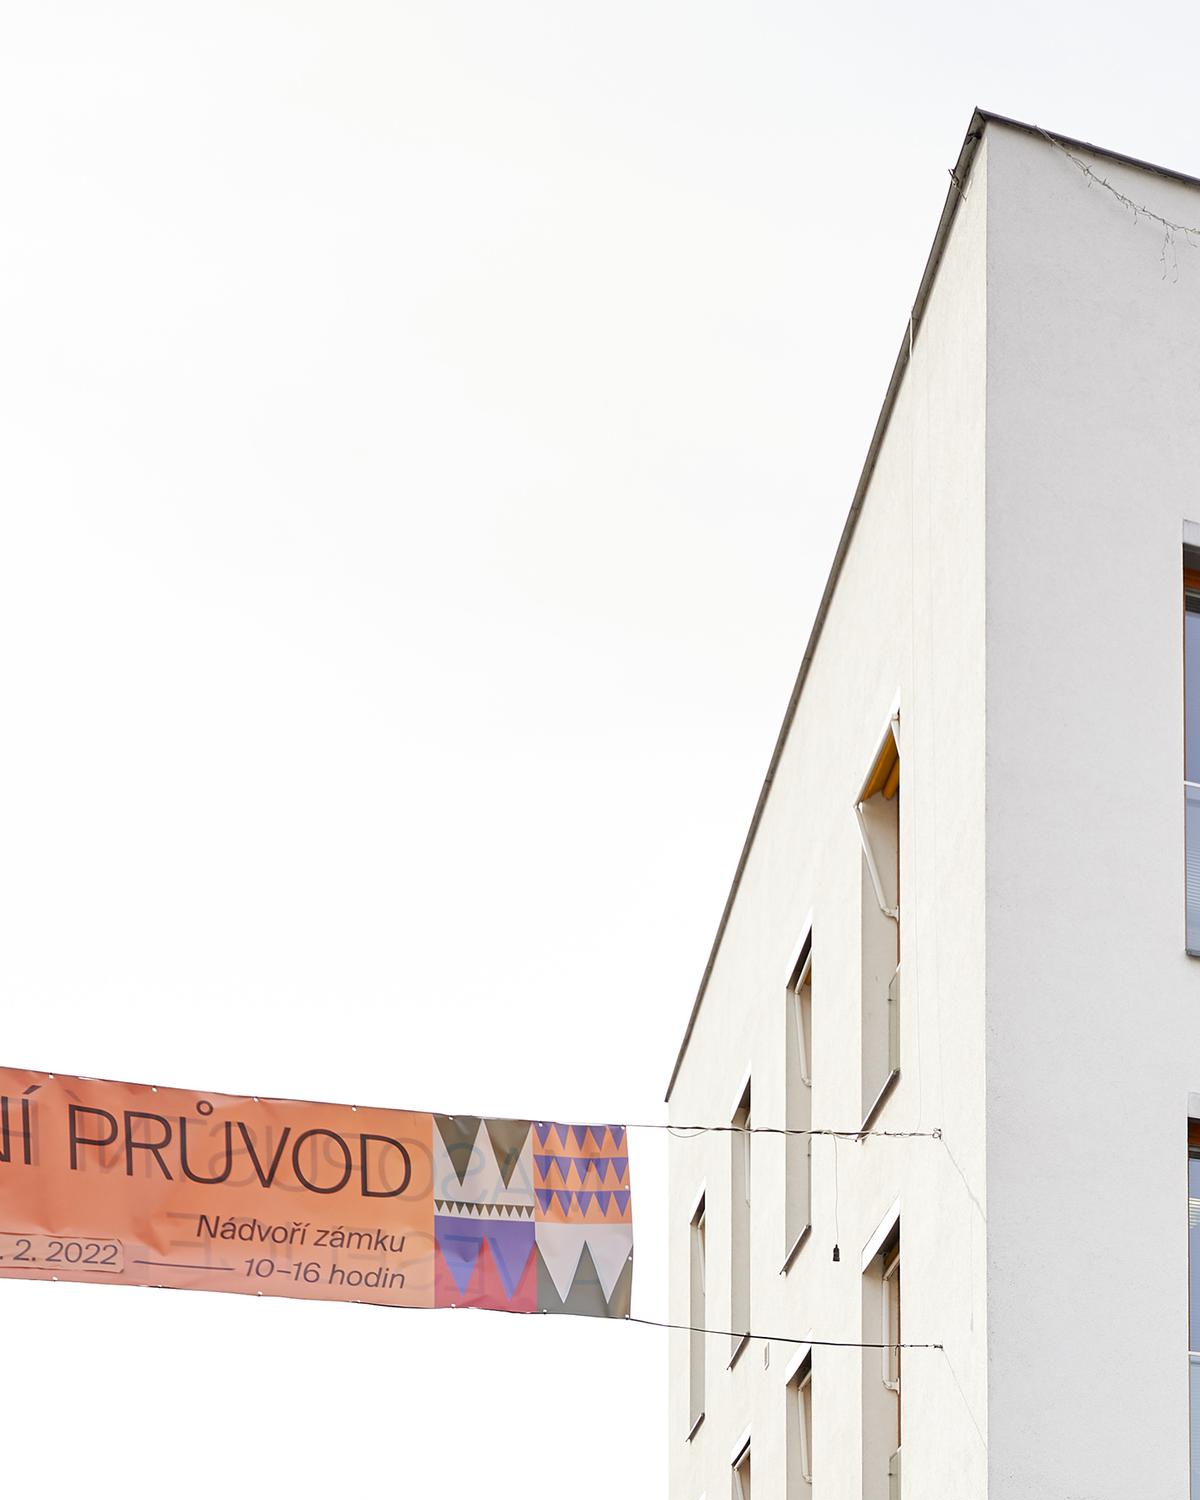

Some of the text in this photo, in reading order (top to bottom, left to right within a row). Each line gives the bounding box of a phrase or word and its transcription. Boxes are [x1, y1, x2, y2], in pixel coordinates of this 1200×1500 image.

[68, 1100, 411, 1198] PRŮVOD
[196, 1214, 405, 1253] Nádvoří zámku
[46, 1241, 118, 1265] 2022
[330, 1262, 405, 1288] hodin
